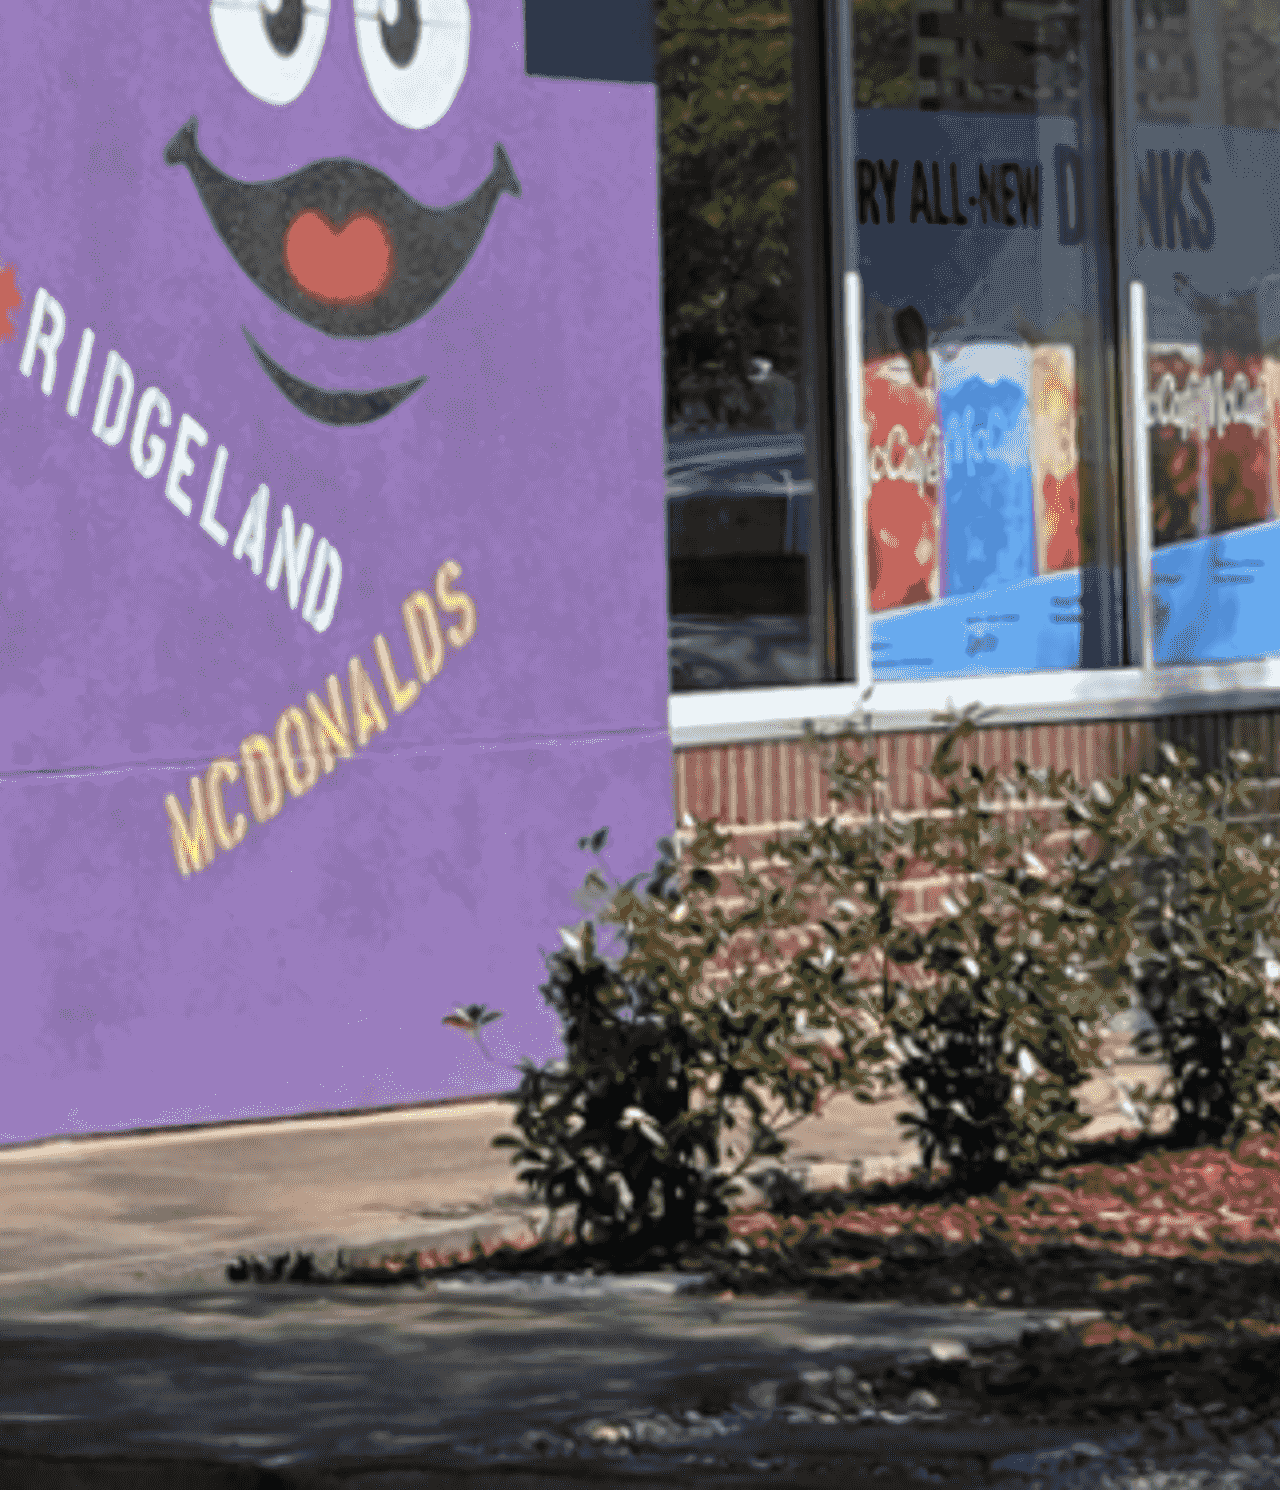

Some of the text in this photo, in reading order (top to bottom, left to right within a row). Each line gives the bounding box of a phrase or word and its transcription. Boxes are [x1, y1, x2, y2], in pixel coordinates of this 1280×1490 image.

[856, 143, 1216, 253] RY ALL-NEW DNKS
[20, 286, 342, 633] RIDGELAND
[164, 558, 478, 879] MCDONALDS
